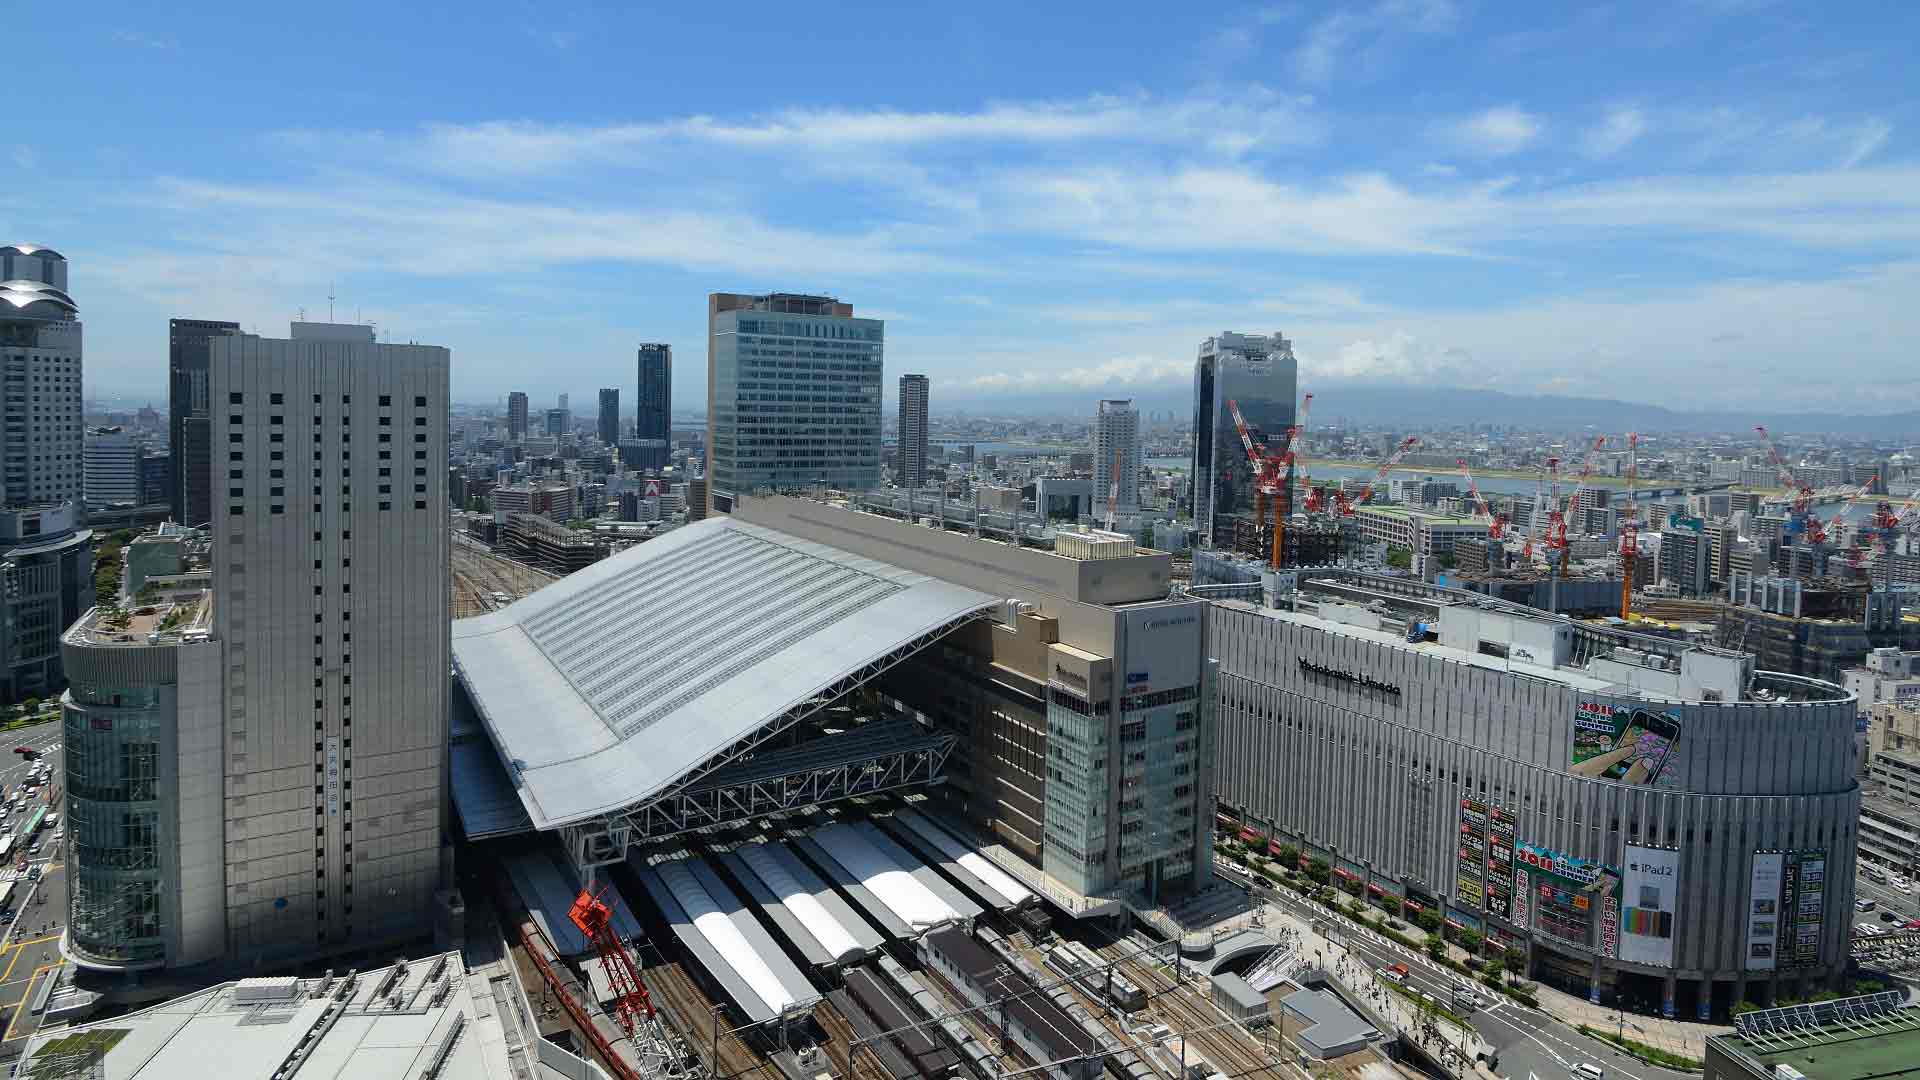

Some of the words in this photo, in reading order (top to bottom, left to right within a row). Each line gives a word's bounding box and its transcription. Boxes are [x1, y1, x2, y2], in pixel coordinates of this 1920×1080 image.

[1577, 703, 1615, 715] 2011
[1577, 711, 1613, 722] SPRING
[1575, 719, 1616, 733] SUMMER
[1462, 833, 1483, 844] パソコン
[1517, 848, 1554, 872] 2011
[1553, 868, 1595, 884] SUMMER
[1641, 863, 1664, 875] iPad
[1665, 866, 1673, 876] 2
